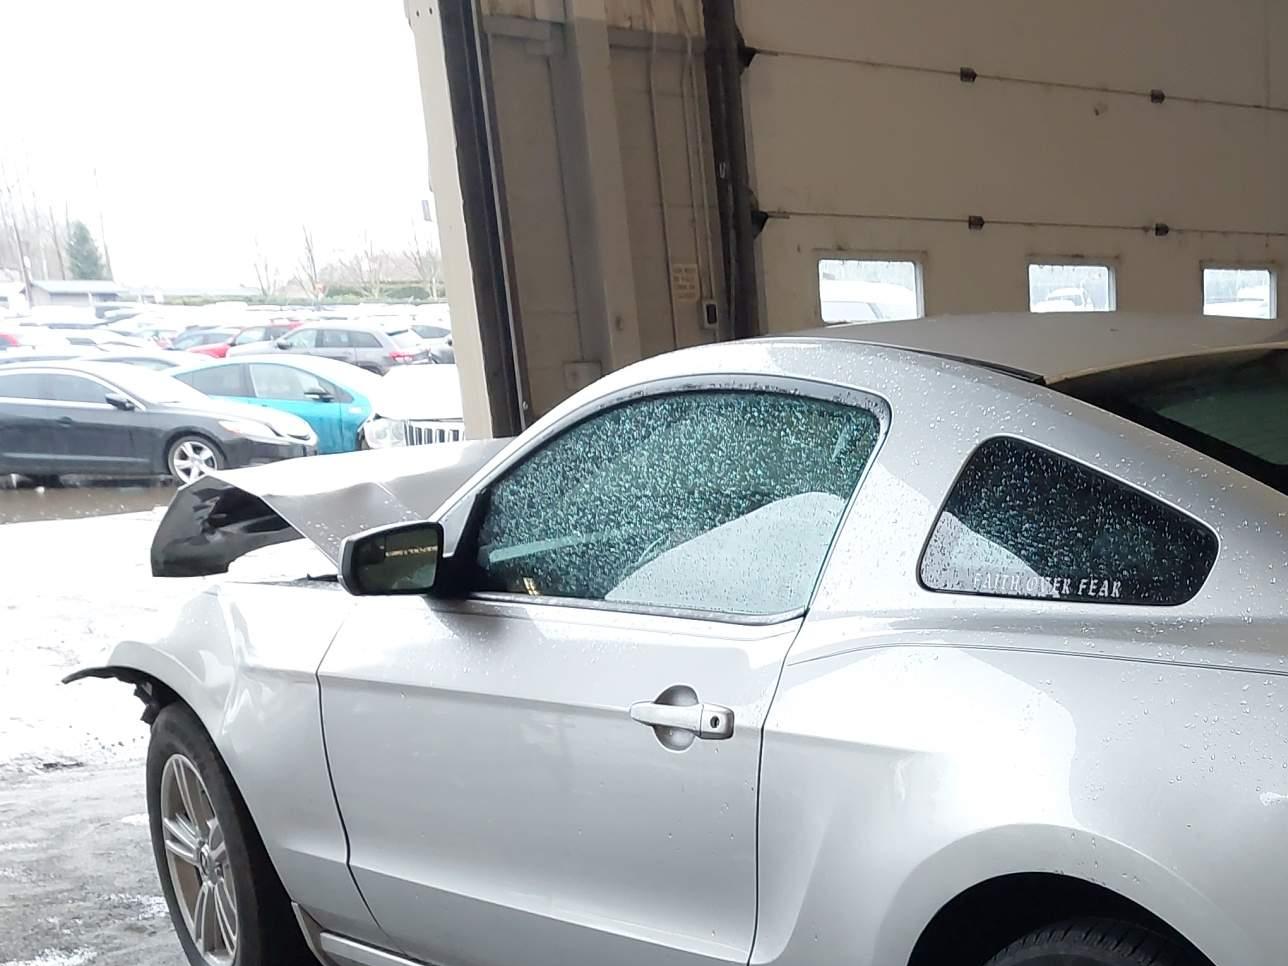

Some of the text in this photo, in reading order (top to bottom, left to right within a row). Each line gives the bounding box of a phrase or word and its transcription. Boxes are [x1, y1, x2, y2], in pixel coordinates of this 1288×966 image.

[973, 572, 1122, 598] FAITH OVER FEAR
